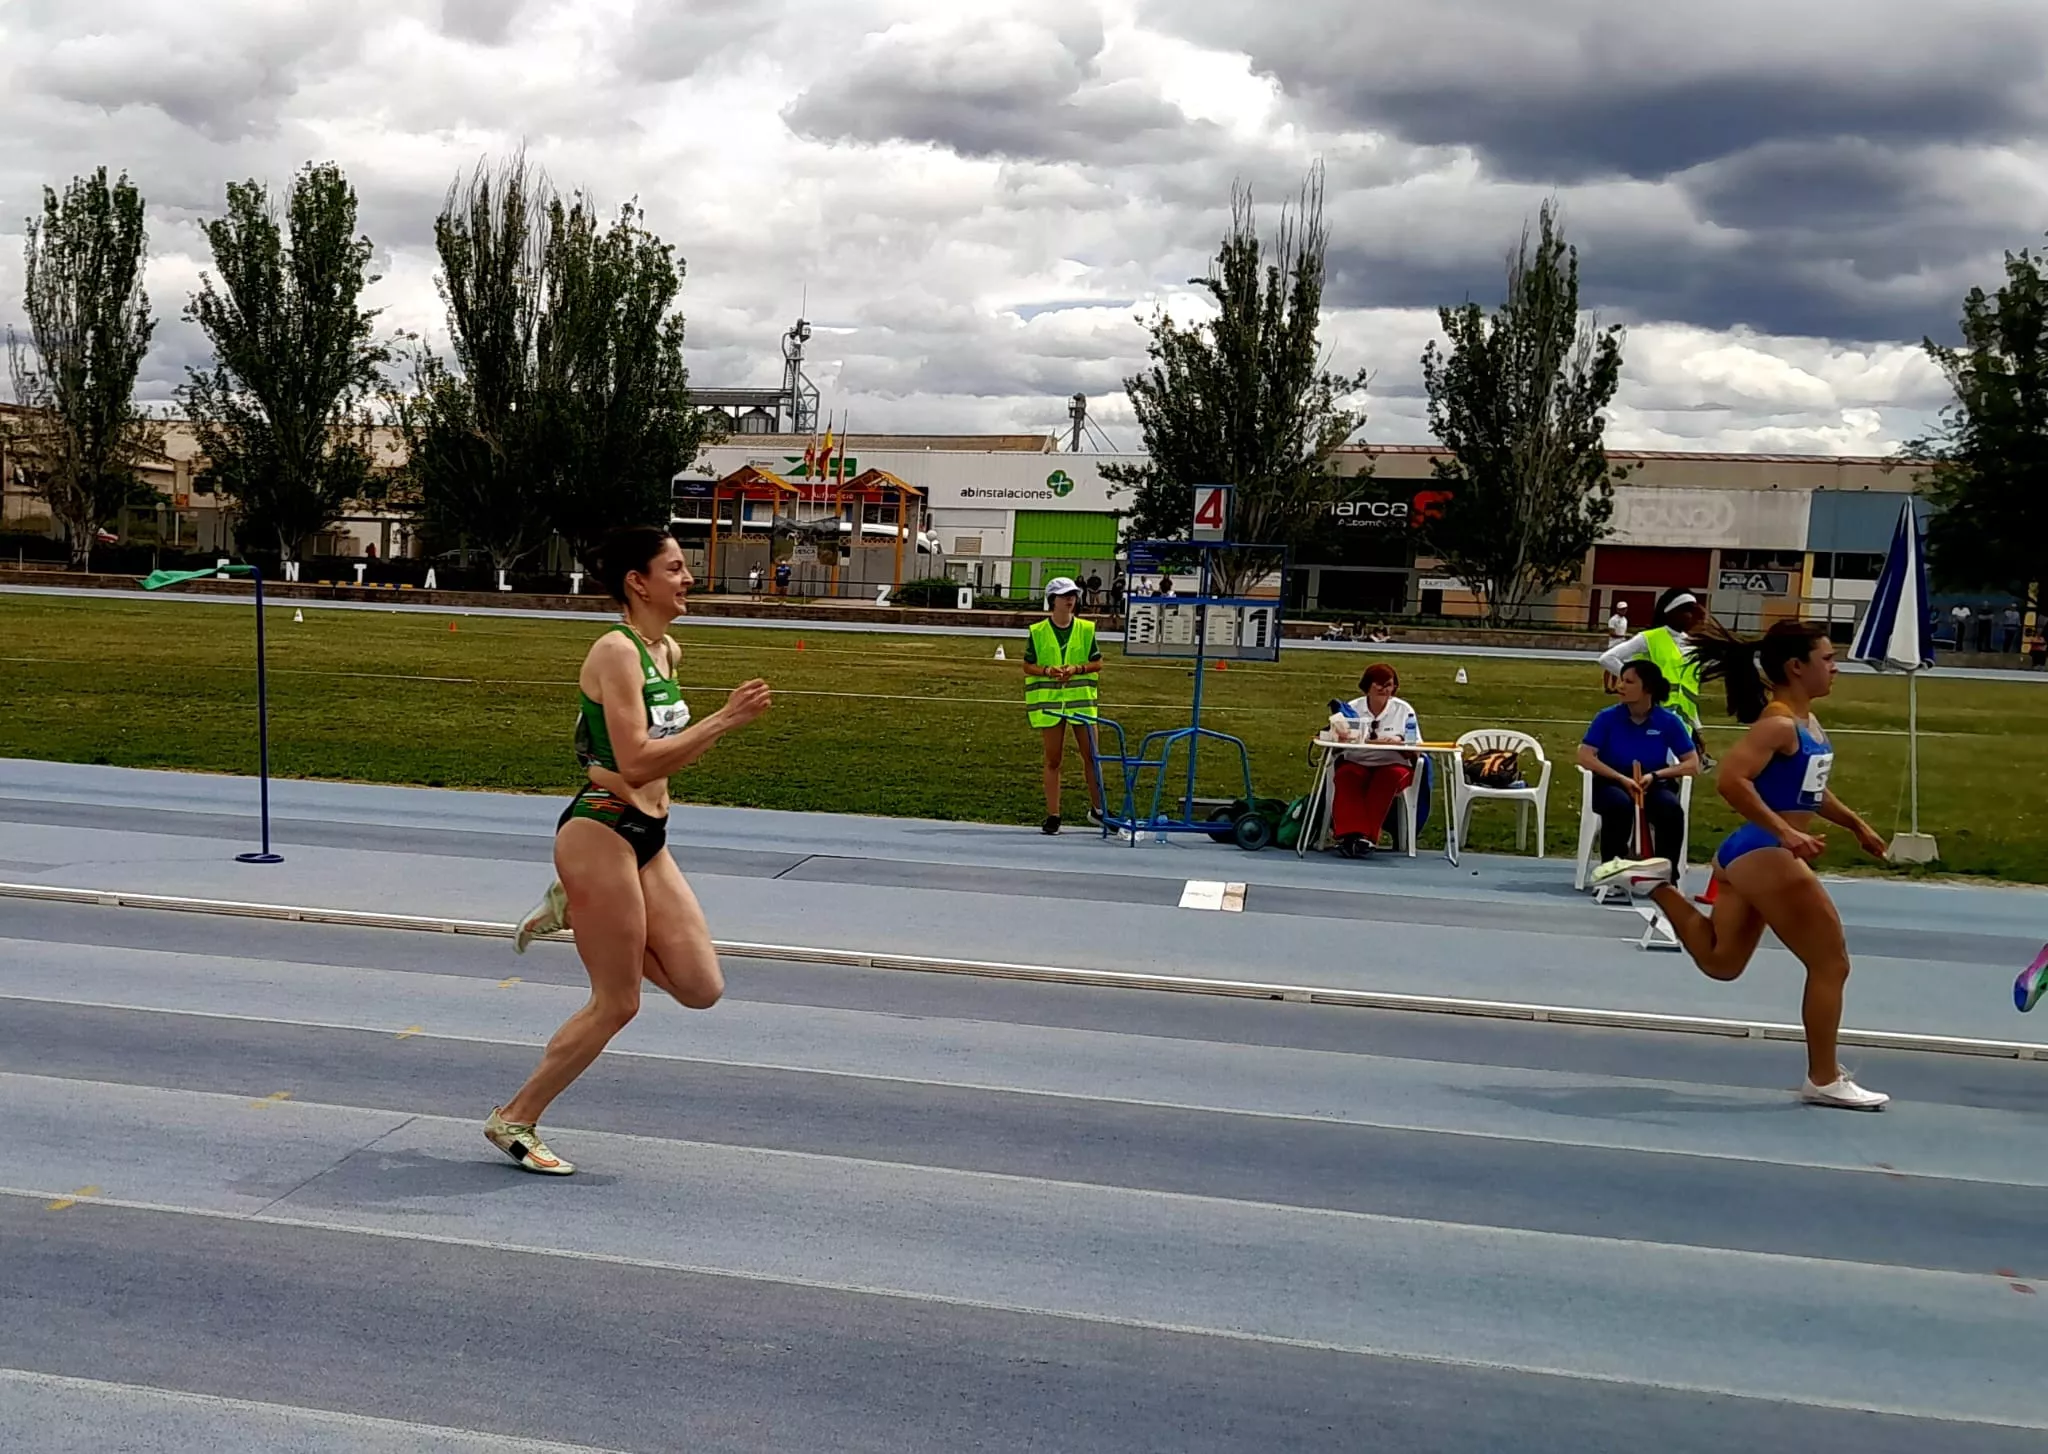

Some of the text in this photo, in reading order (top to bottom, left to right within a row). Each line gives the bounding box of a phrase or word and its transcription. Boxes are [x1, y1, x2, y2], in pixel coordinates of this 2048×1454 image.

[960, 487, 1053, 500] abinstalaciones
[1195, 488, 1223, 529] 4
[1248, 609, 1269, 647] 1
